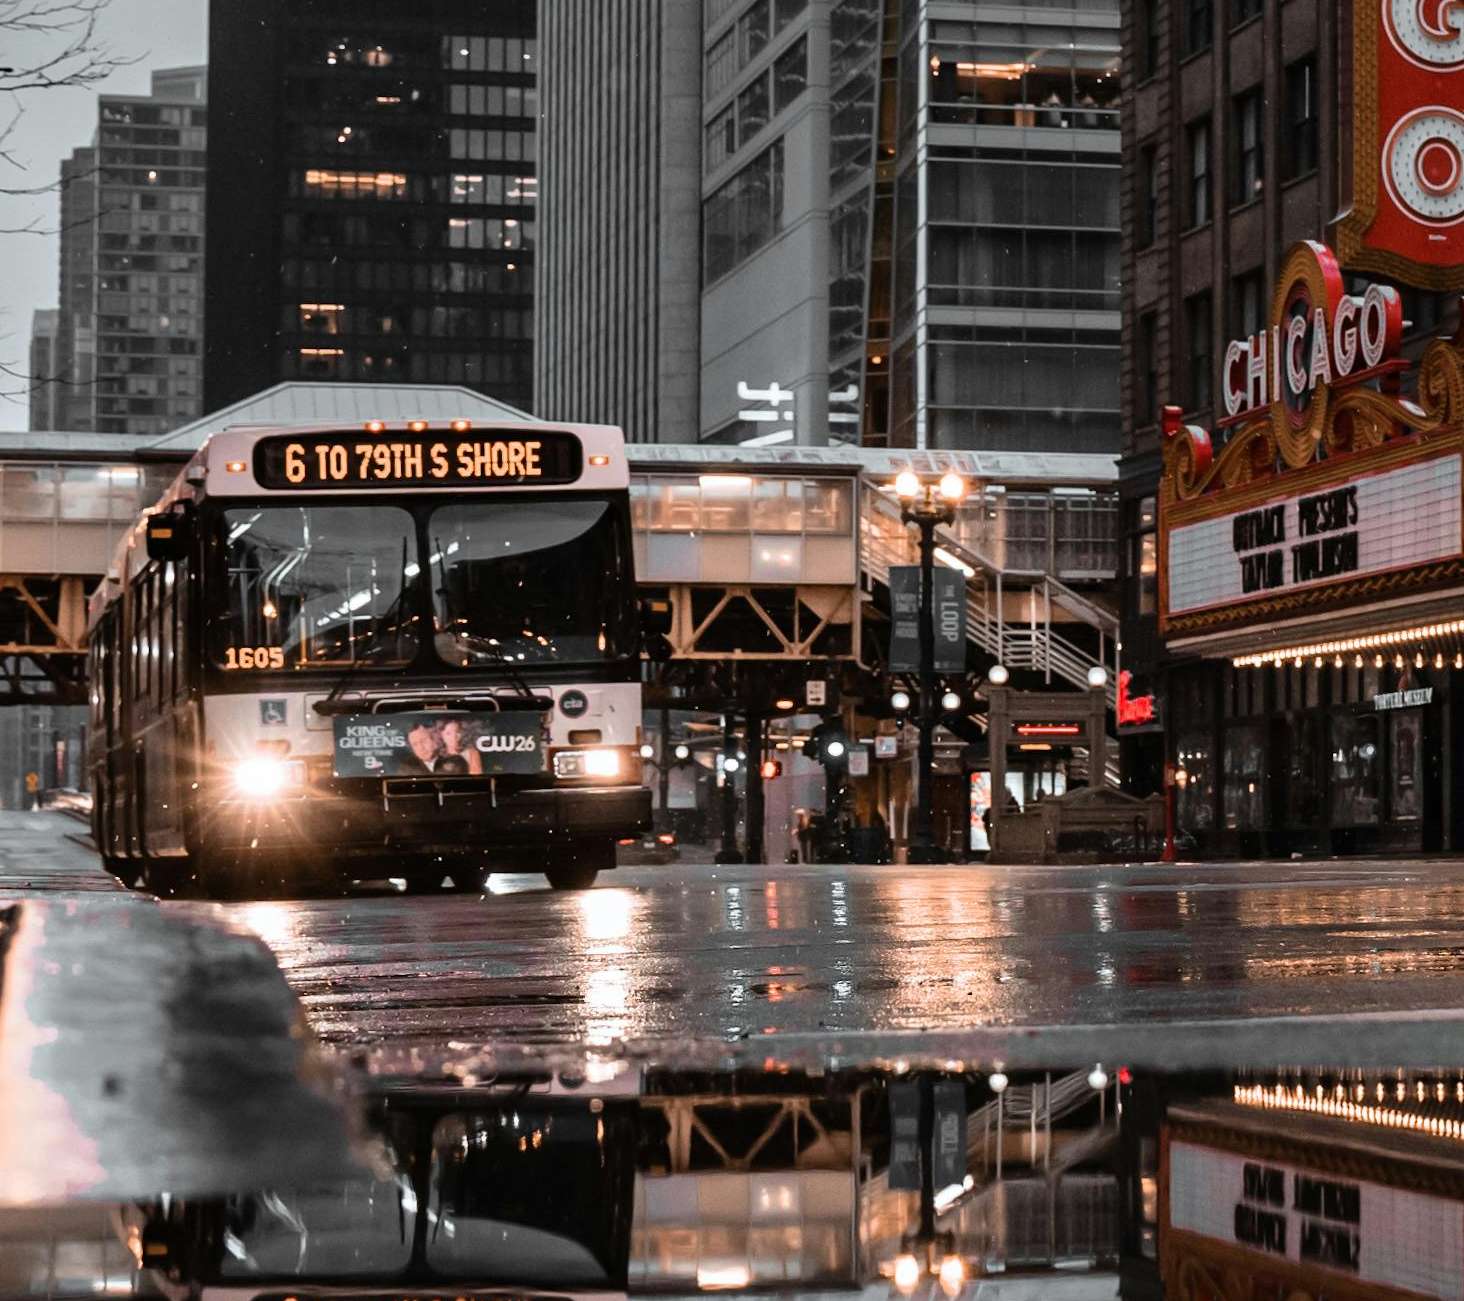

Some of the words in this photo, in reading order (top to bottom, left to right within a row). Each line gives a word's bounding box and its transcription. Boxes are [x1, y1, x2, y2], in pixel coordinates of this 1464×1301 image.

[1223, 283, 1387, 417] CHICAGO
[285, 443, 306, 484] 6
[315, 443, 348, 480] TO
[355, 443, 424, 480] 79TH
[430, 442, 449, 479] S
[456, 441, 542, 478] SHORE
[225, 647, 284, 670] 1605
[339, 736, 406, 749] QUEENS
[346, 725, 385, 737] KING
